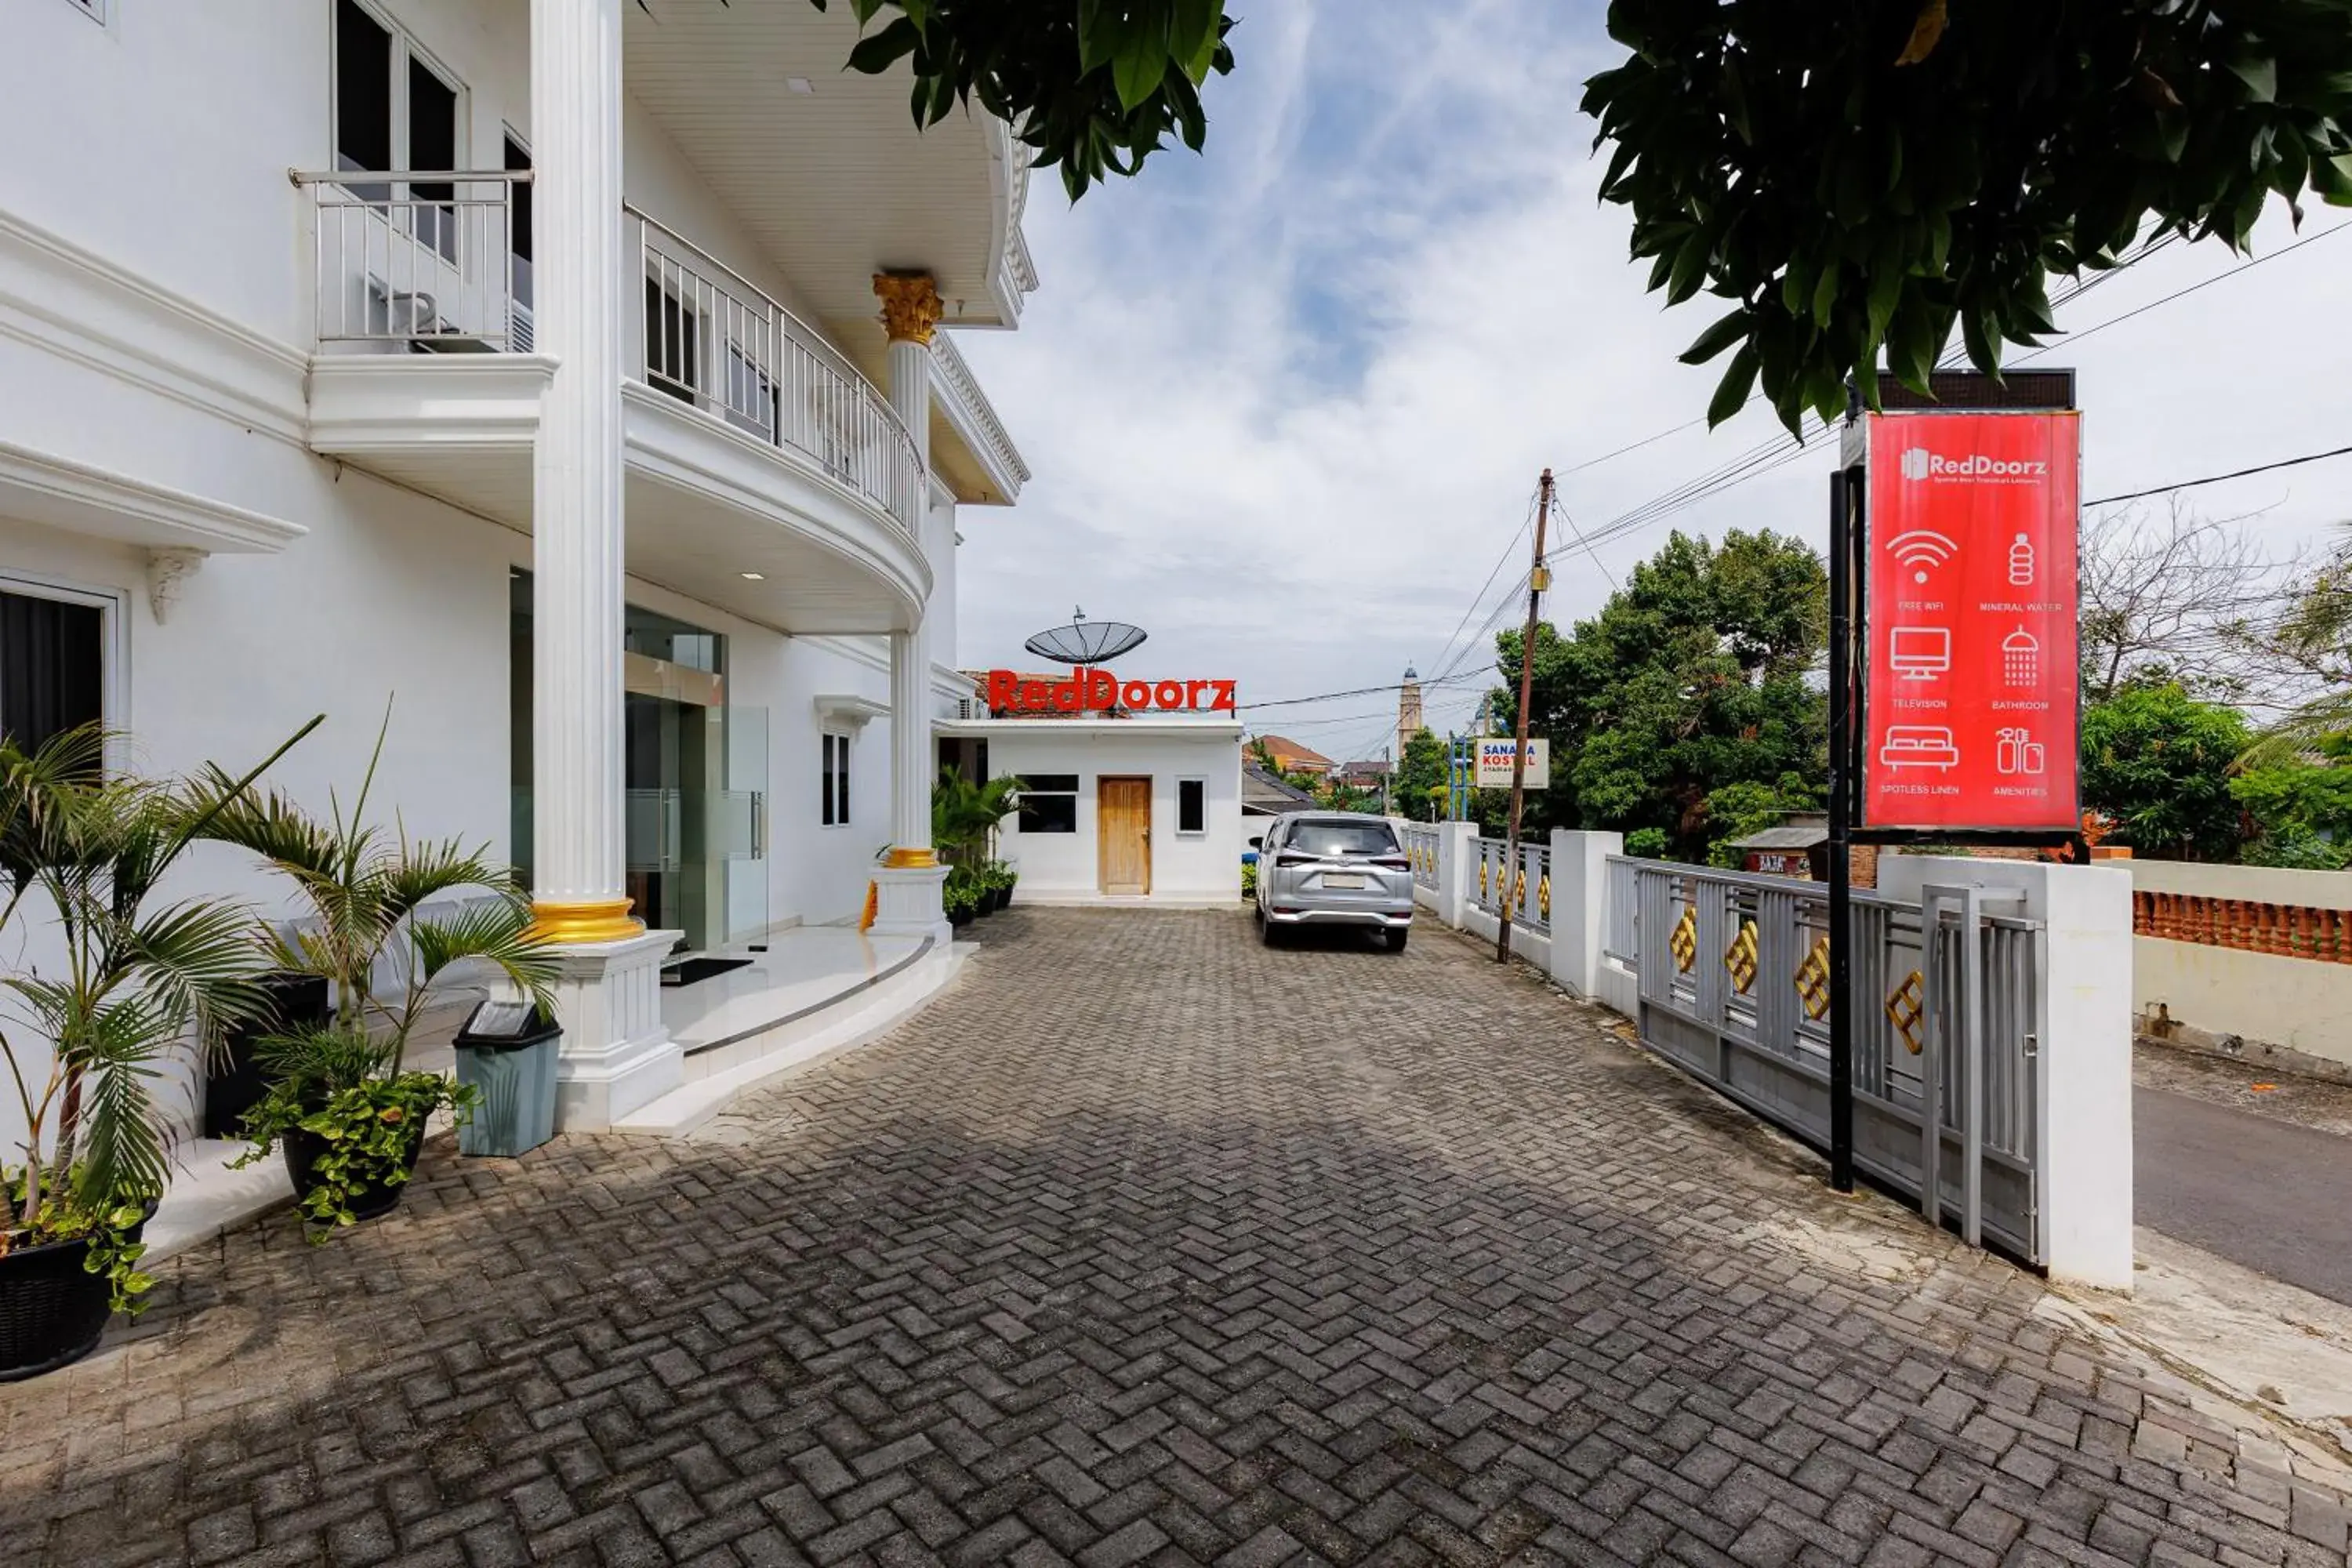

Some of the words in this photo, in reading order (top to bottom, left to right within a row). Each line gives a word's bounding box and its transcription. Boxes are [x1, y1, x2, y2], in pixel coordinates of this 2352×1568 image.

[1930, 455, 2045, 474] RedDoorz
[1898, 601, 1921, 611] FREE
[1980, 602, 2023, 612] MINERAL
[2027, 602, 2063, 612] WATER
[989, 666, 1236, 711] RedDoorz
[1893, 699, 1947, 709] TELEVISION
[1483, 746, 1536, 755] SANAA
[1483, 755, 1534, 765] KOSL
[1881, 785, 1929, 794] SPOTLESS
[1931, 786, 1959, 794] LINEN
[1994, 786, 2048, 797] AMENITIES
